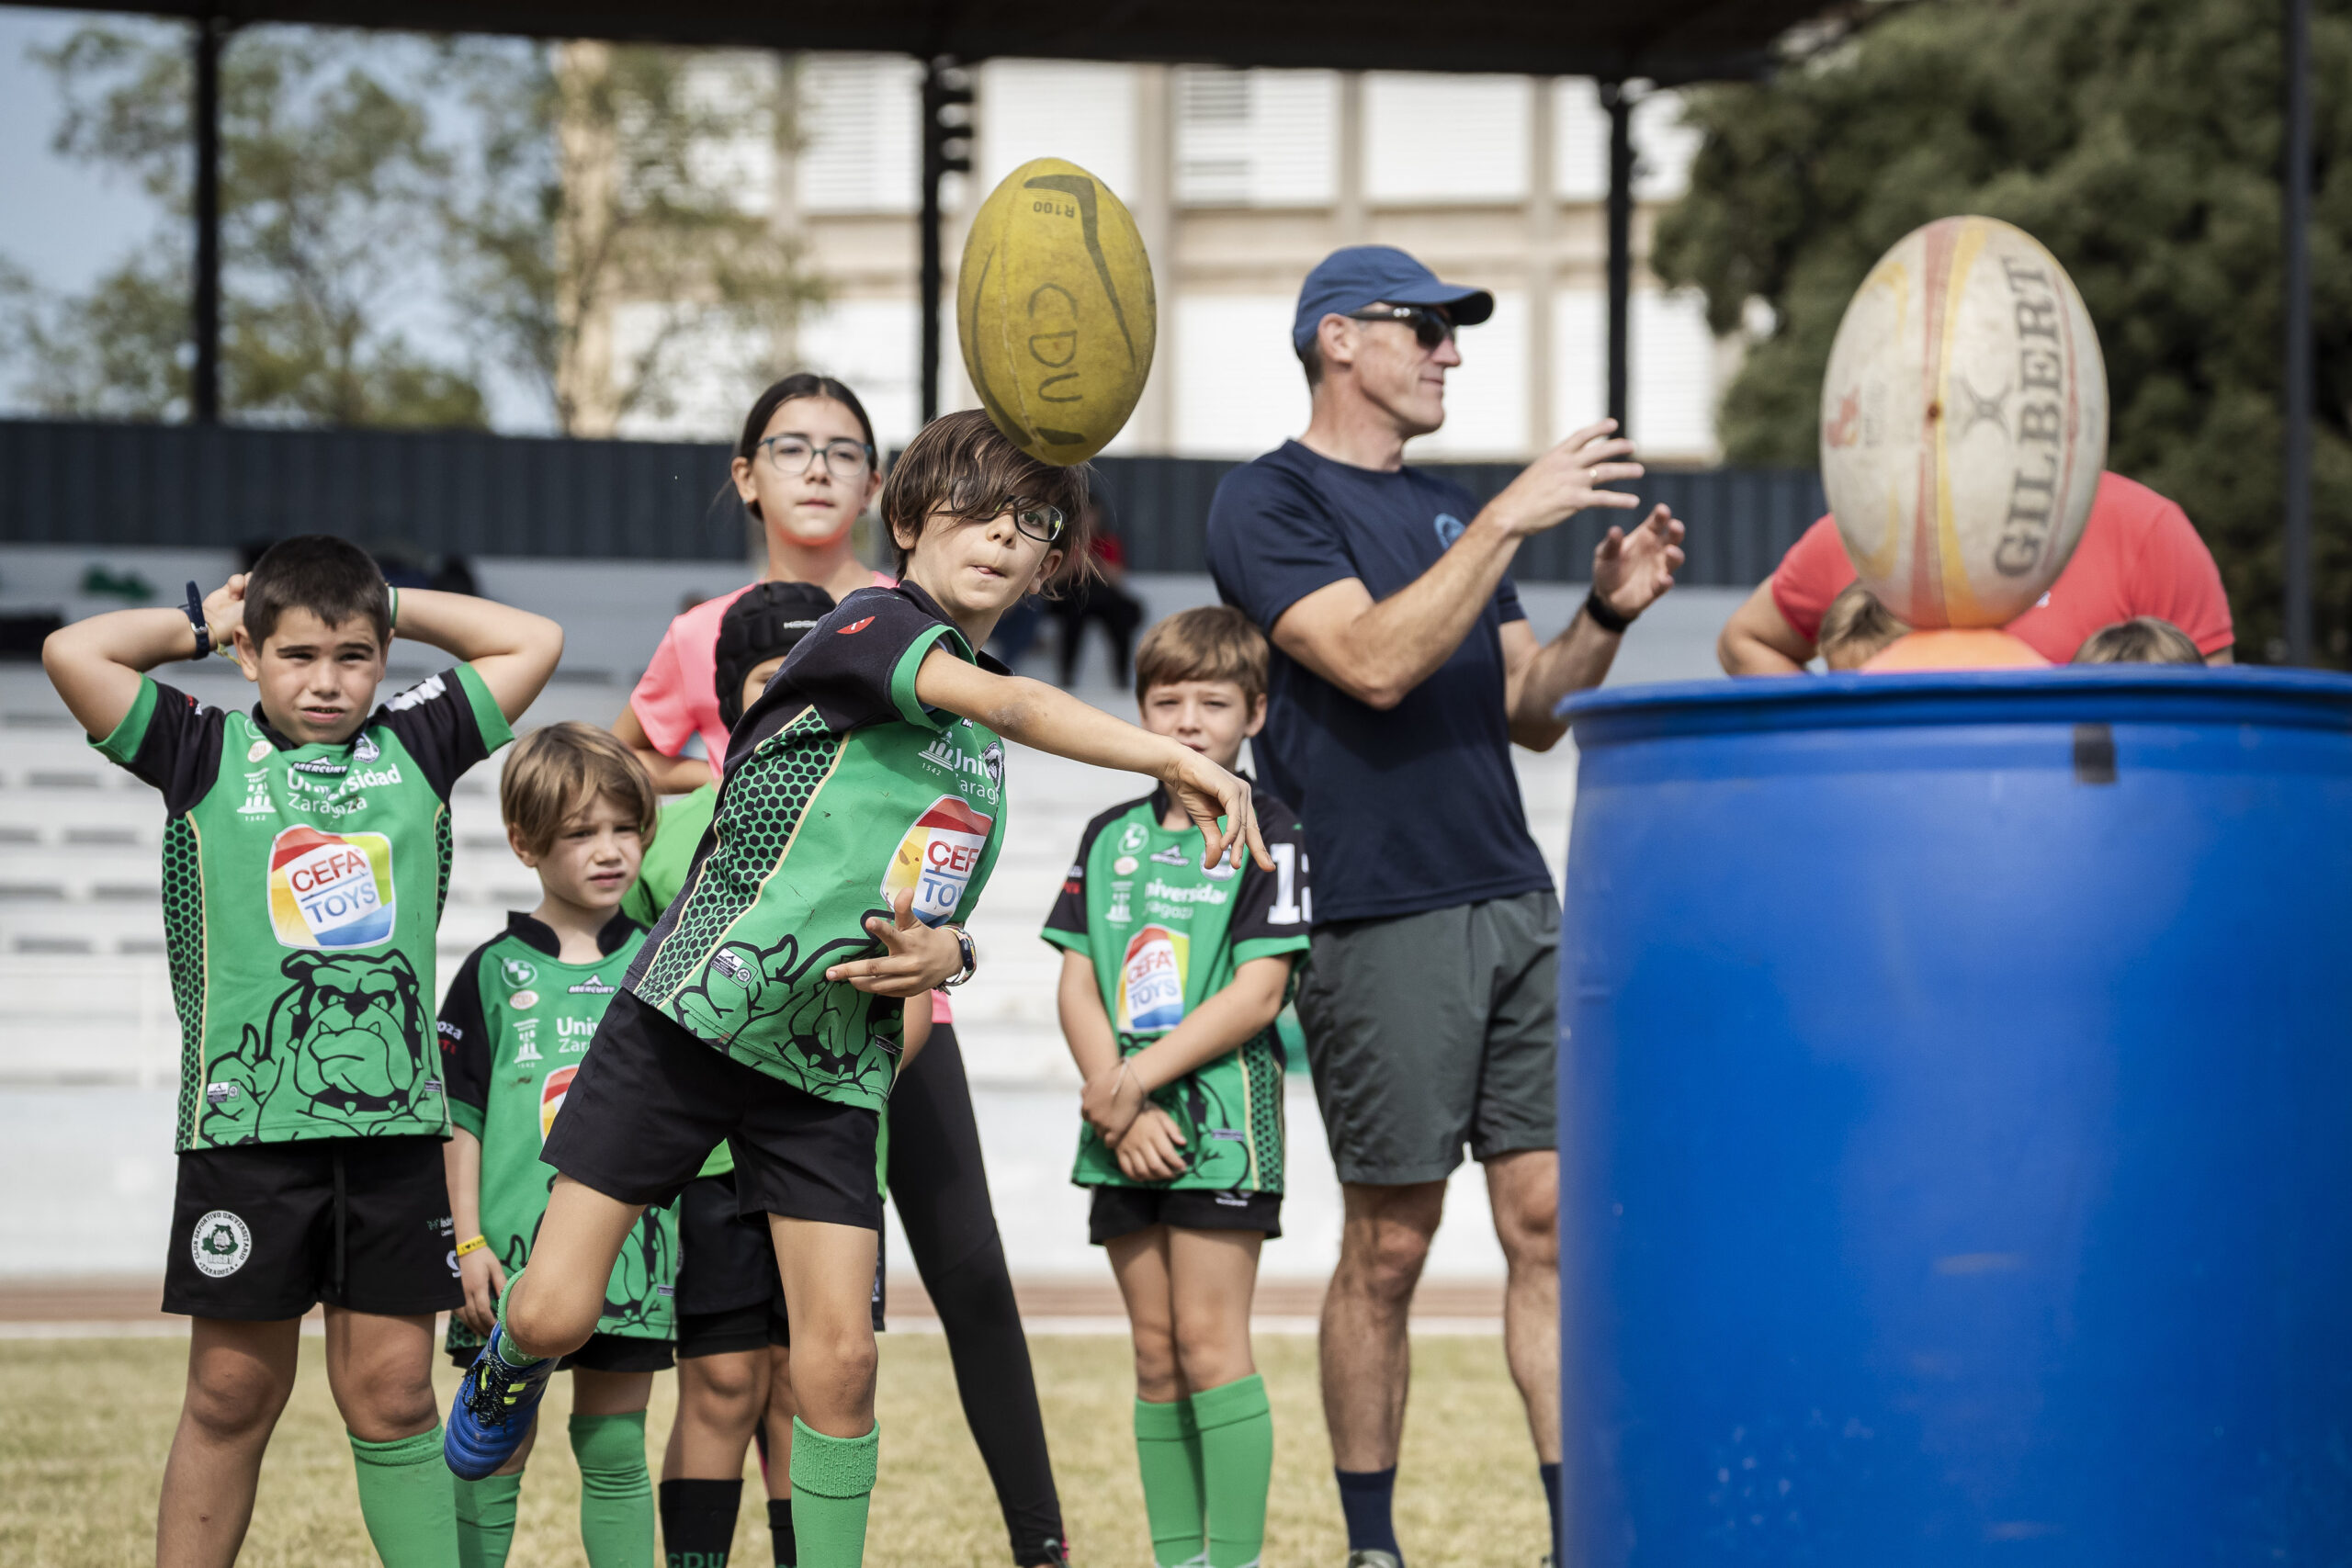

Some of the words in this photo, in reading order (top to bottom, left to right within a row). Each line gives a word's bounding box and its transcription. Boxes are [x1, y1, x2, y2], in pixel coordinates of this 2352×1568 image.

[1032, 199, 1076, 219] R100
[1026, 282, 1083, 403] CDU
[1991, 254, 2063, 578] GILBERT
[292, 761, 349, 773] MERCURY
[922, 762, 942, 777] 1542
[291, 850, 367, 892] CEFA
[304, 881, 377, 923] TOYS
[568, 985, 616, 995] MERCURY
